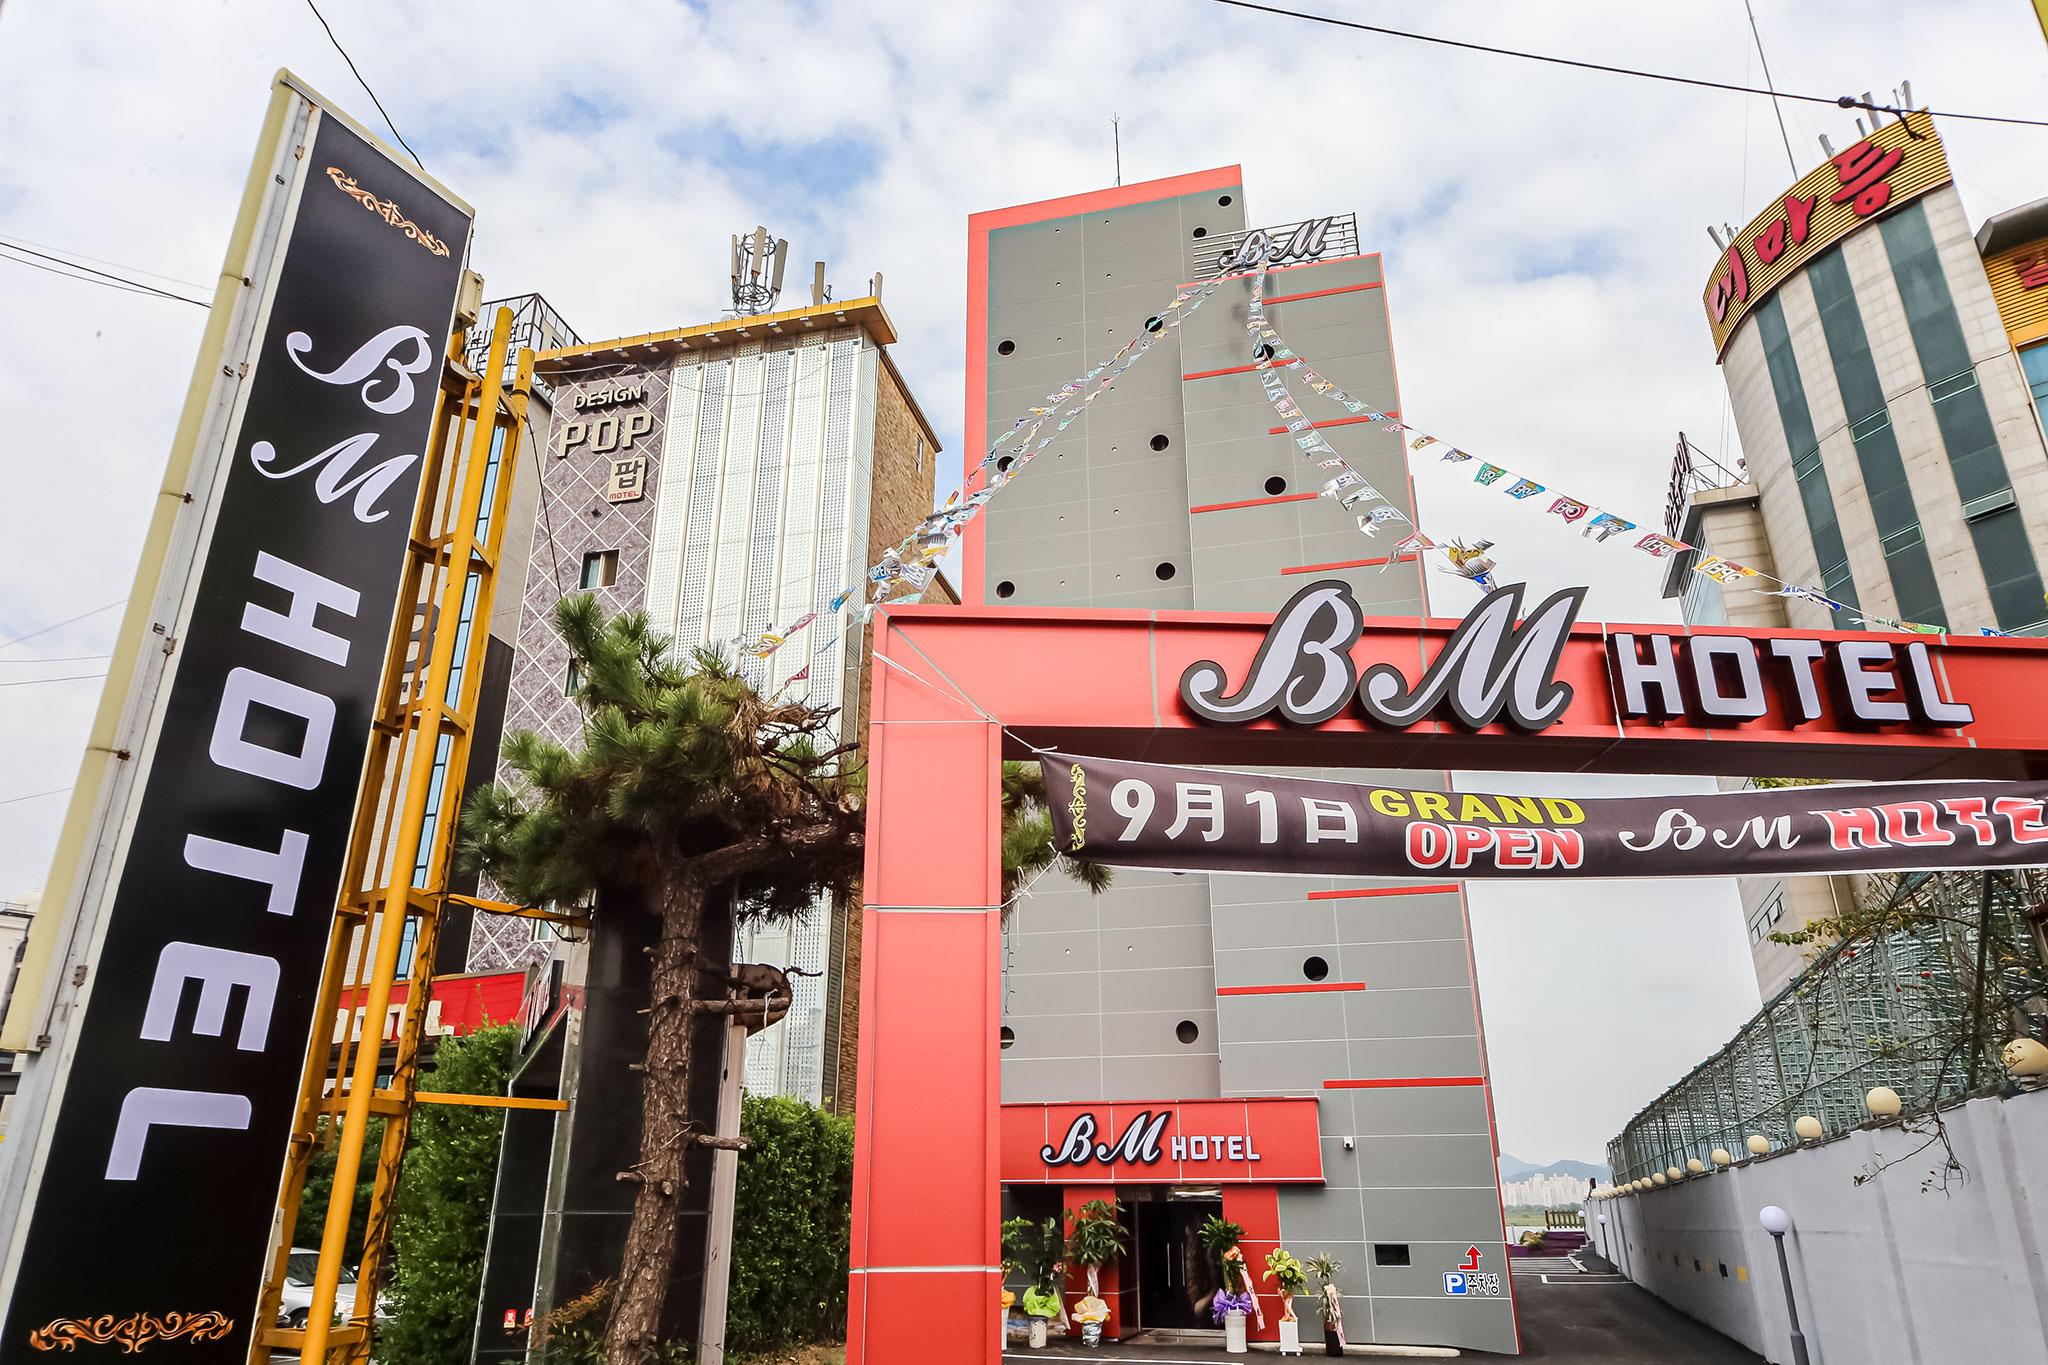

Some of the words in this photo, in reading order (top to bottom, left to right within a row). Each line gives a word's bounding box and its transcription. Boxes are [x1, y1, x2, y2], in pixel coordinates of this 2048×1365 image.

[573, 384, 643, 410] DESIGN
[557, 411, 653, 458] POP
[615, 459, 643, 490] 팝
[609, 490, 640, 500] MOTEL
[1613, 632, 1975, 724] HOTEL
[1369, 788, 1586, 825] GRAND
[1807, 796, 2048, 851] HOTE
[1405, 820, 1585, 870] OPEN
[105, 550, 362, 1181] HOTEL
[1170, 1134, 1262, 1162] HOTEL
[1467, 1272, 1500, 1296] 주차장
